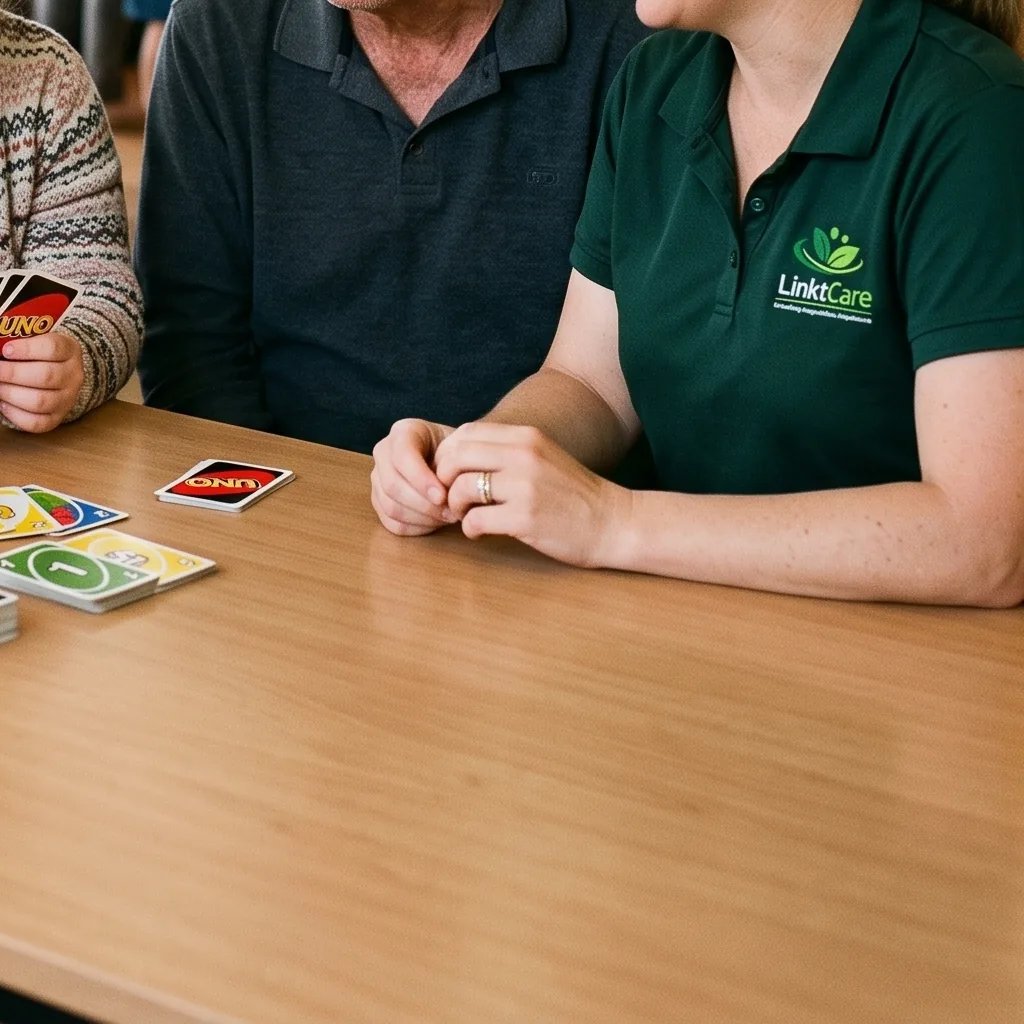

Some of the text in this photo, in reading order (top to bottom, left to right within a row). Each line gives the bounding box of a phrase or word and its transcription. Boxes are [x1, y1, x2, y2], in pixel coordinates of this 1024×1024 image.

[778, 274, 872, 308] LinktCare
[184, 477, 262, 489] UNO
[48, 561, 88, 577] 1
